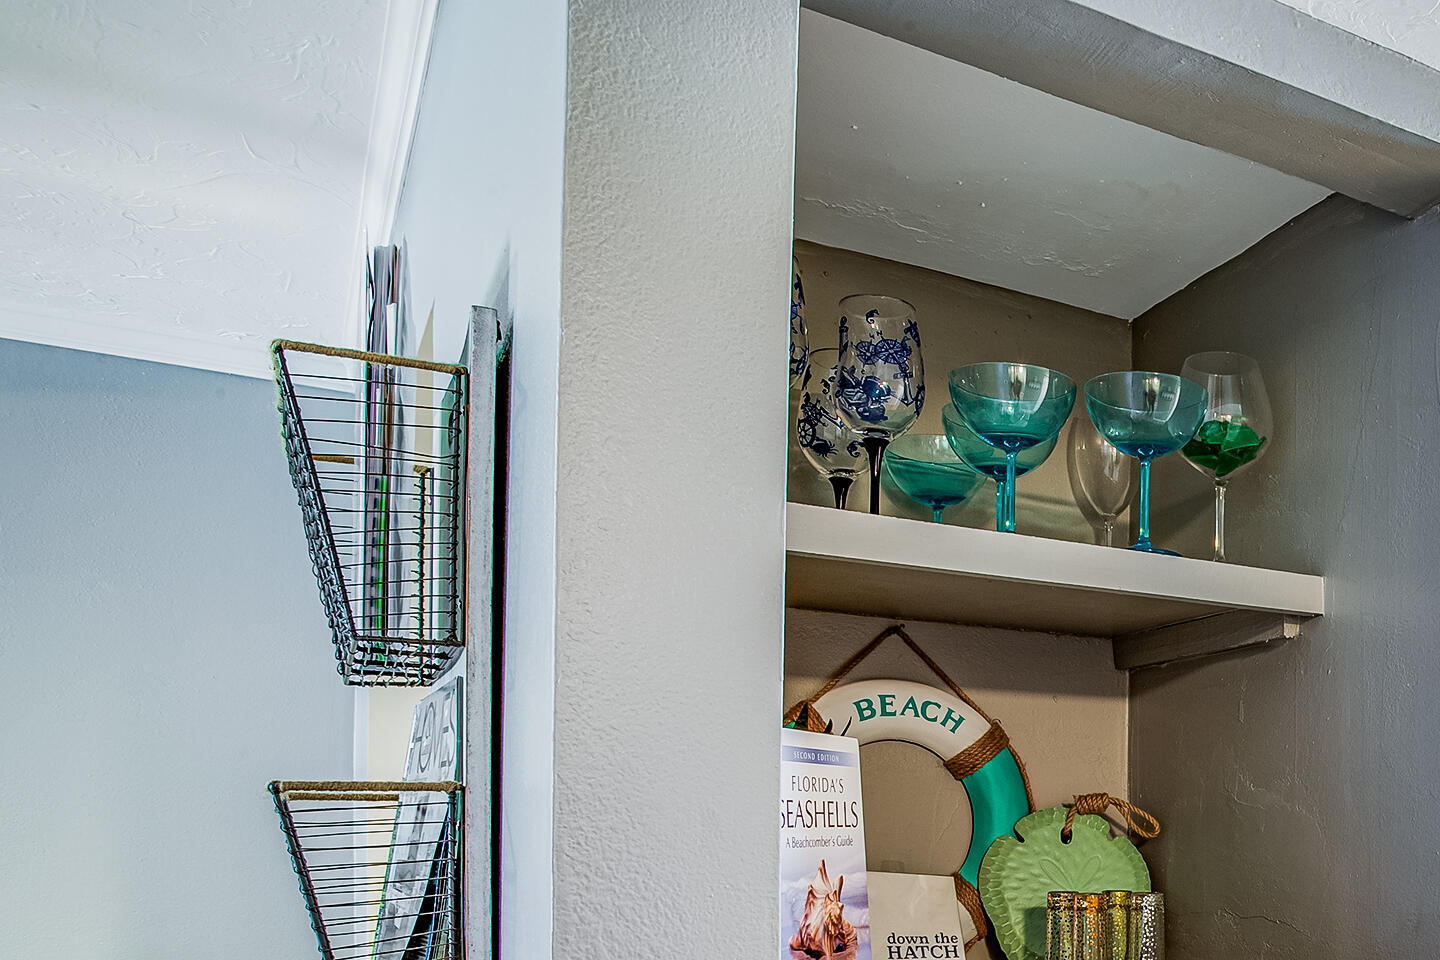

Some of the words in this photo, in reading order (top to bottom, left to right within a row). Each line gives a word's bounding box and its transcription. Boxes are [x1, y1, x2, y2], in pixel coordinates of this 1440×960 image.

[852, 694, 966, 734] BEACH
[793, 751, 816, 761] SECOND
[817, 752, 840, 763] EDITION
[791, 775, 845, 794] FLORIDA'S
[785, 837, 791, 848] A
[792, 835, 836, 849] Beachcomber's
[836, 834, 854, 847] Guide
[887, 932, 929, 944] down
[935, 932, 959, 944] the
[887, 945, 960, 960] HATCH
